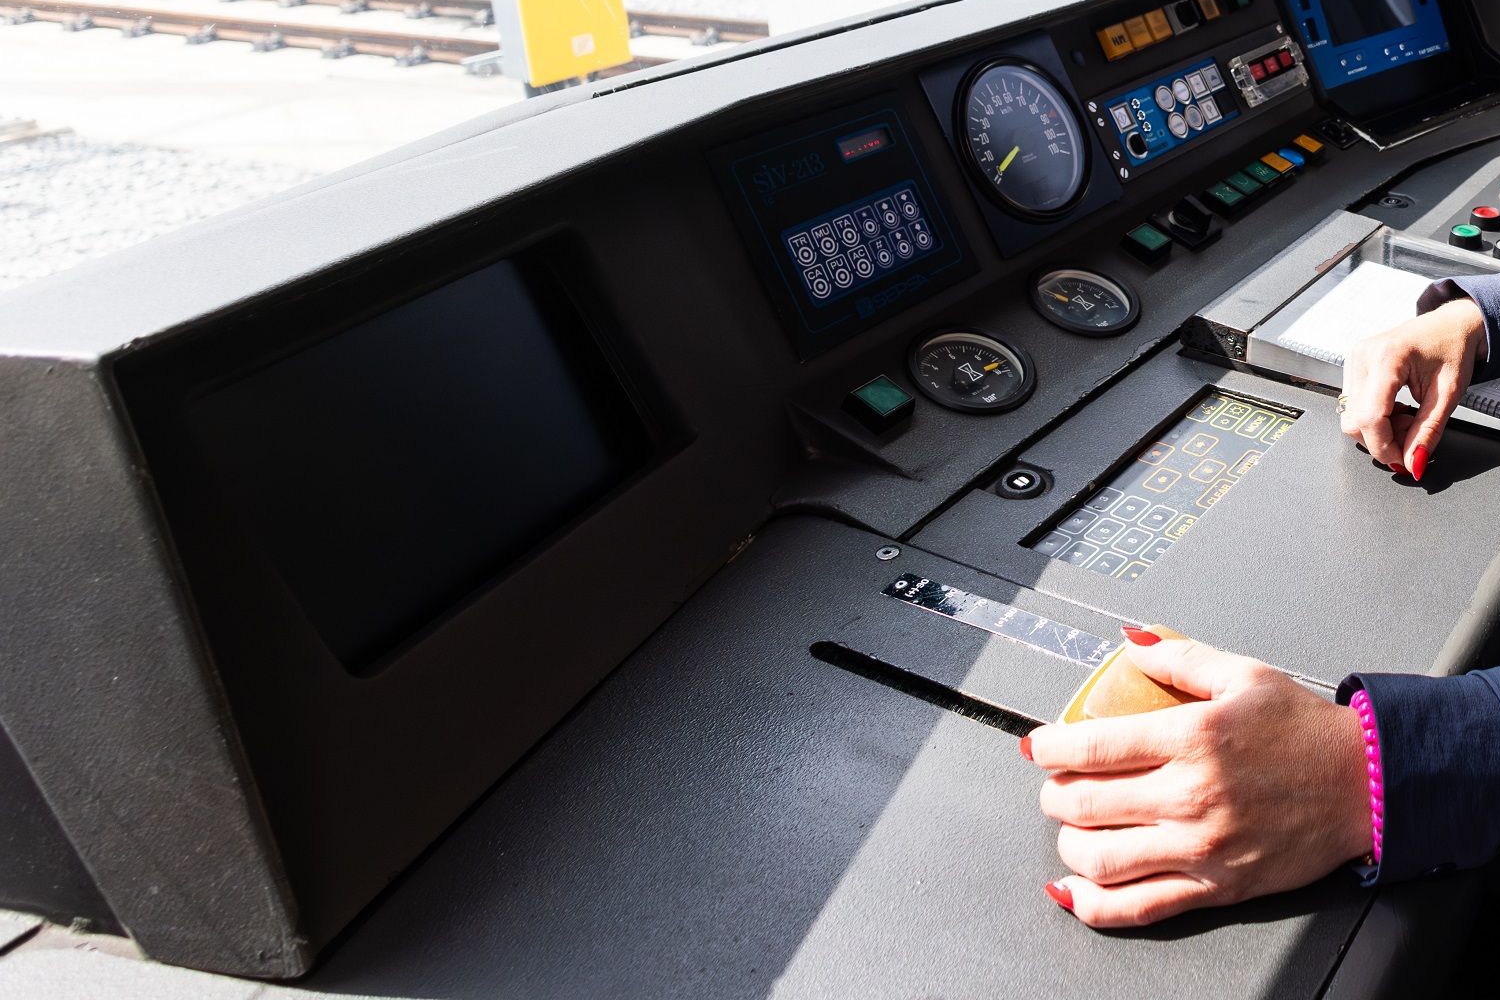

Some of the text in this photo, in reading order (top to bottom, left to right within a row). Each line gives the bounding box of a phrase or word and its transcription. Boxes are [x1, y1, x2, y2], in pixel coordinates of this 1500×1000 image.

[991, 95, 1002, 107] 50
[1016, 95, 1026, 107] 70
[984, 104, 994, 116] 40
[1029, 103, 1039, 115] 80
[980, 117, 990, 130] 30
[979, 132, 989, 145] 20
[1044, 128, 1056, 141] 100
[984, 150, 994, 162] 10
[837, 220, 851, 229] TA
[815, 227, 830, 239] MU
[793, 236, 807, 248] TR
[853, 249, 866, 260] AC
[831, 258, 843, 270] PU
[808, 269, 822, 280] CA
[982, 393, 998, 404] bar
[1245, 415, 1267, 433] MODE
[1270, 422, 1291, 441] HOME
[1100, 561, 1110, 570] 7
